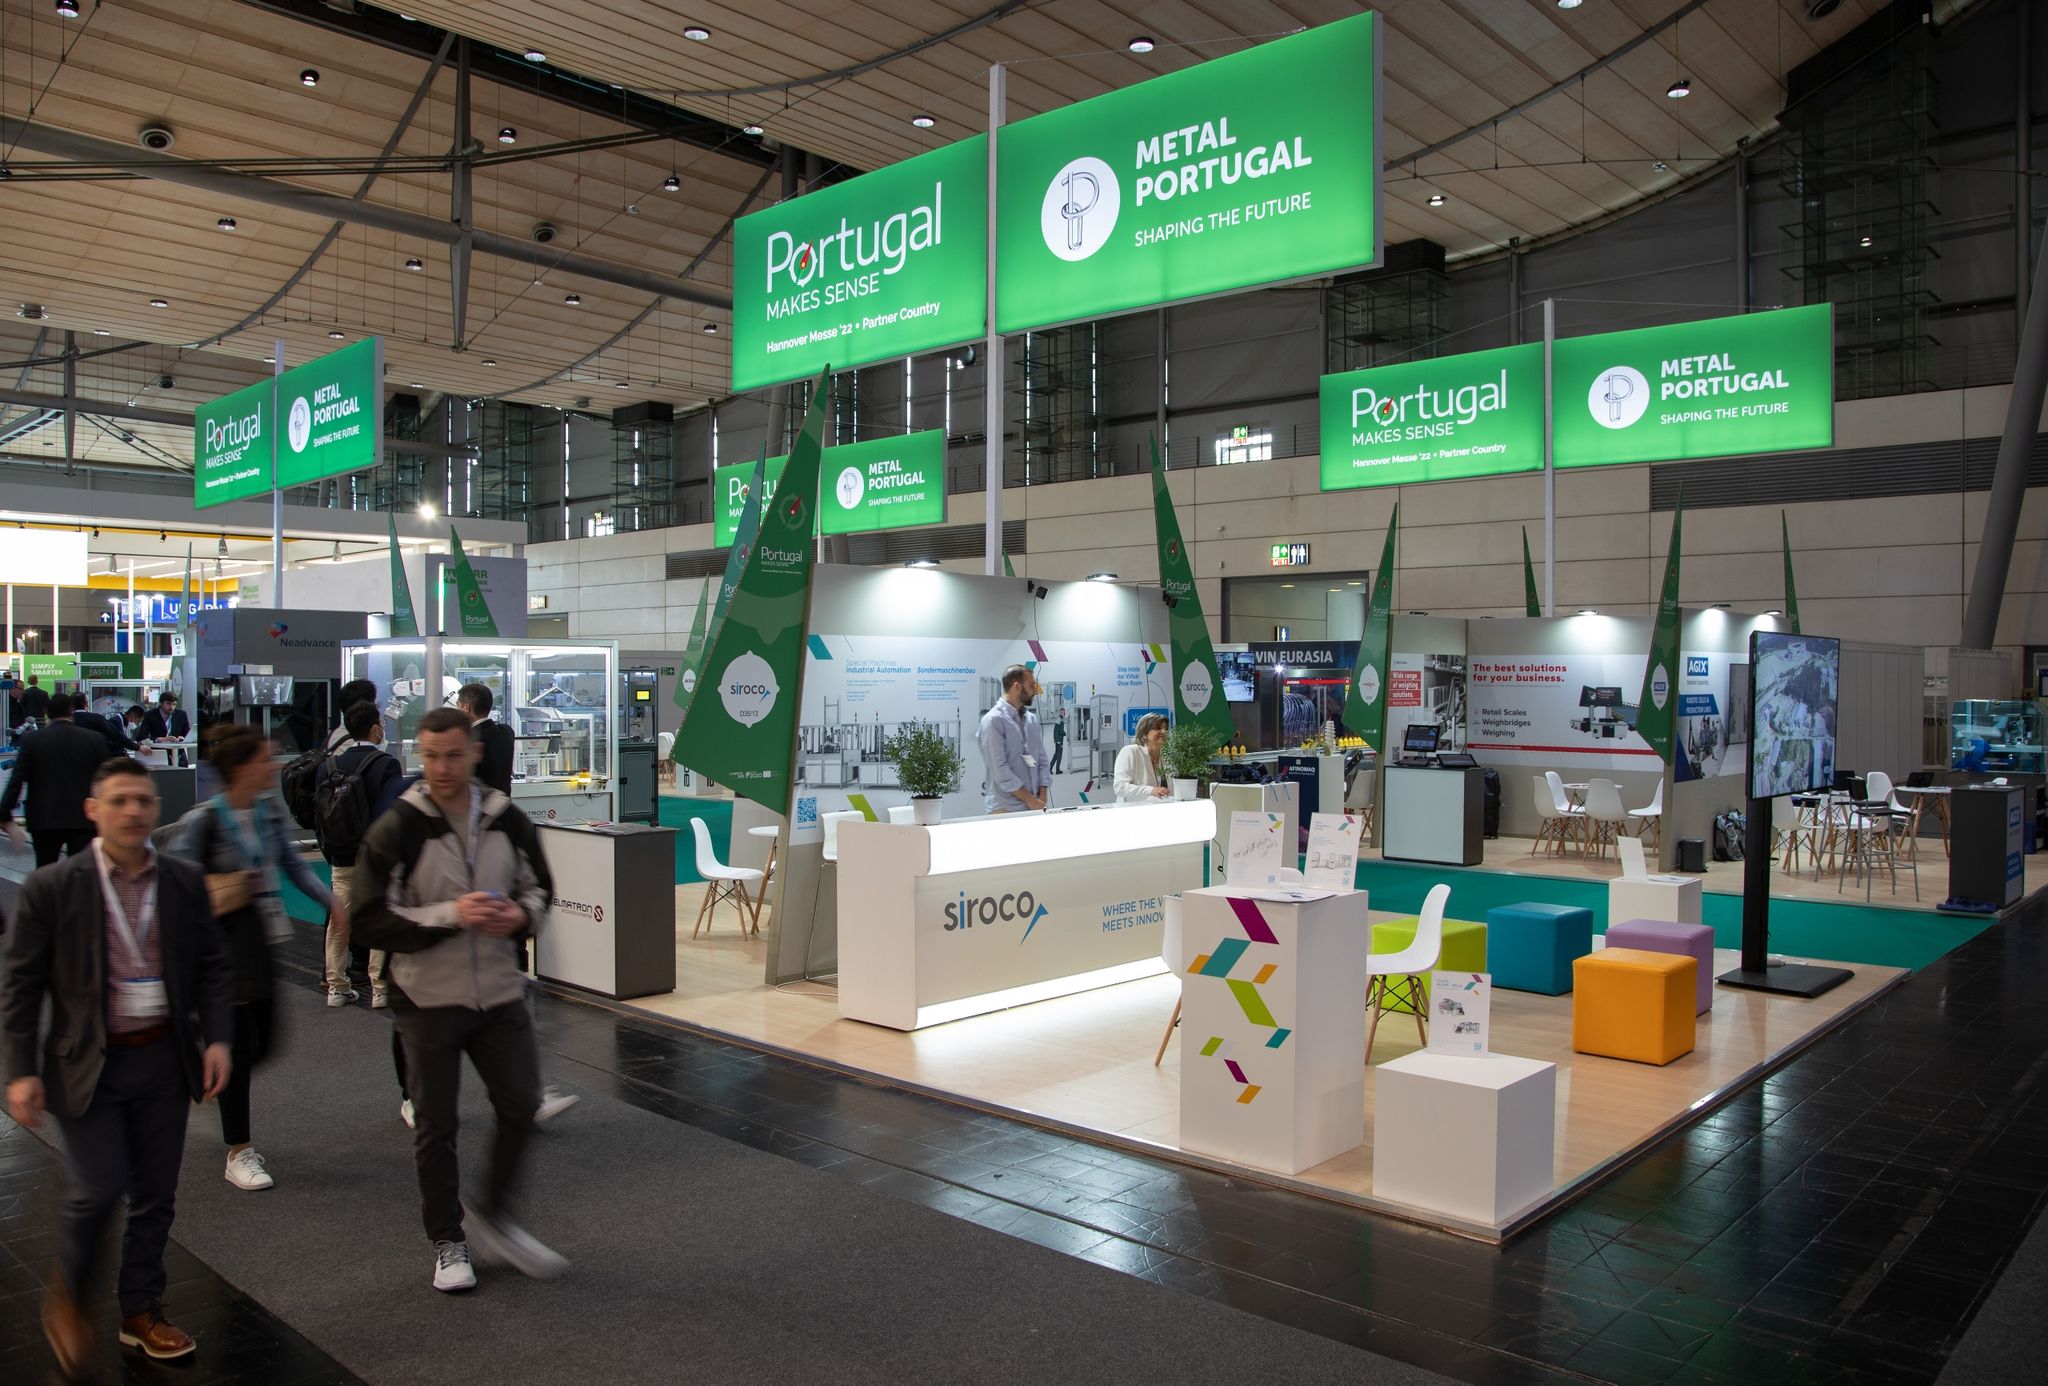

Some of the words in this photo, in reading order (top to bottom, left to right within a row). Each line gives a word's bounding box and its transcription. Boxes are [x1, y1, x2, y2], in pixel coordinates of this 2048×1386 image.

[1135, 117, 1236, 170] METAL
[1135, 136, 1312, 207] PORTUGAL
[1134, 217, 1204, 248] SHAPING
[1208, 208, 1240, 230] THE
[1245, 191, 1312, 223] FUTURE
[766, 182, 942, 293] Portugal
[766, 289, 820, 321] MAKES
[824, 272, 880, 305] SENSE
[766, 334, 808, 353] Hannover
[809, 326, 838, 343] Messe
[862, 311, 898, 331] Partner
[900, 301, 941, 321] Country
[1661, 353, 1735, 378] METAL
[314, 383, 341, 406] METAL
[1661, 370, 1789, 401] PORTUGAL
[1352, 368, 1507, 428] Portugal
[314, 396, 360, 427] PORTUGAL
[1660, 409, 1712, 425] SHAPING
[1714, 406, 1738, 419] THE
[1741, 402, 1789, 417] FUTURE
[206, 402, 261, 454] Portugal
[313, 434, 333, 448] SHAPING
[333, 431, 342, 441] THE
[342, 425, 360, 438] FUTURE
[1352, 428, 1402, 447] MAKES
[1405, 421, 1455, 441] SENSE
[205, 455, 224, 469] MAKES
[224, 450, 242, 464] SENSE
[1352, 456, 1391, 468] Hannover
[1391, 453, 1418, 465] Messe
[1439, 447, 1470, 459] Partner
[1471, 443, 1506, 456] Country
[868, 459, 902, 476] METAL
[868, 471, 925, 491] PORTUGAL
[868, 495, 892, 507] SHAPING
[892, 495, 902, 503] THE
[903, 492, 925, 502] FUTURE
[761, 546, 803, 565] Portugal
[1166, 578, 1191, 593] Portugal
[465, 614, 489, 624] Portugal
[280, 638, 336, 648] Neadvance
[1280, 650, 1334, 663] EURASIA
[1688, 660, 1707, 673] AGIX
[916, 666, 977, 674] Sondermaschinenbau
[1473, 664, 1491, 672] The
[1494, 664, 1516, 672] best
[1519, 664, 1567, 672] solutions
[1473, 673, 1487, 682] for
[1490, 674, 1513, 683] your
[1516, 673, 1565, 682] business.
[730, 683, 766, 695] siroco
[1186, 681, 1206, 692] siroco
[1503, 708, 1527, 716] Scales
[1482, 719, 1532, 728] Weighbridges
[1482, 729, 1516, 738] Weighing
[943, 890, 1035, 932] siroco
[1102, 901, 1137, 917] WHERE
[1139, 897, 1156, 910] THE
[1102, 916, 1134, 932] MEETS
[1136, 911, 1165, 926] INNOV
